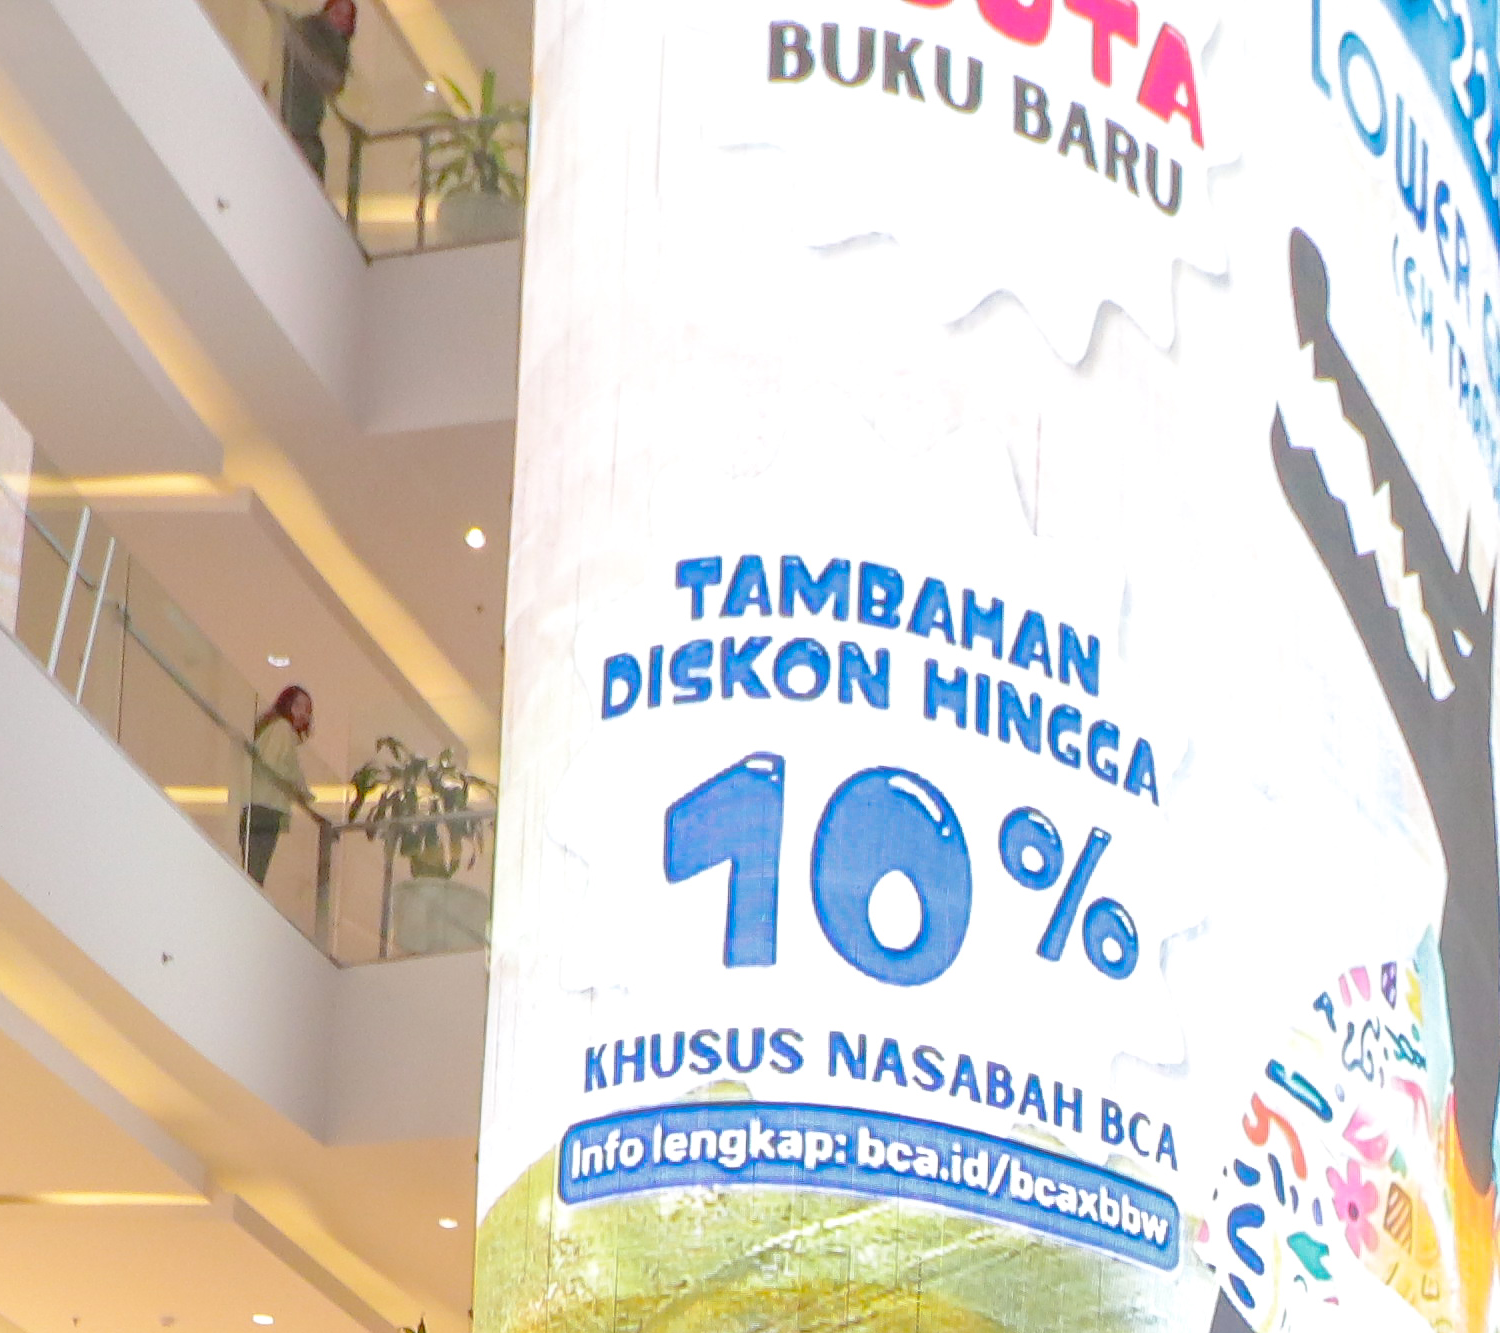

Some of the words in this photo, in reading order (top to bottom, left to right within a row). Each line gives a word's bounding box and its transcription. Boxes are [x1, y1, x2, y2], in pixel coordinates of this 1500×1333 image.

[767, 21, 984, 114] BUKU
[1013, 75, 1184, 217] BARU
[675, 553, 1101, 697] TAMBAHAN
[601, 635, 890, 720] DISKON
[923, 658, 1160, 806] HINGGA
[663, 751, 1140, 987] 10%
[583, 1027, 804, 1093] KHUSUS
[828, 1030, 1083, 1132] NASABAH
[1100, 1097, 1179, 1172] BCA
[570, 1125, 644, 1180] Info
[652, 1119, 848, 1170] lengkap:
[856, 1126, 1171, 1247] bca.id/bcaxbbw
